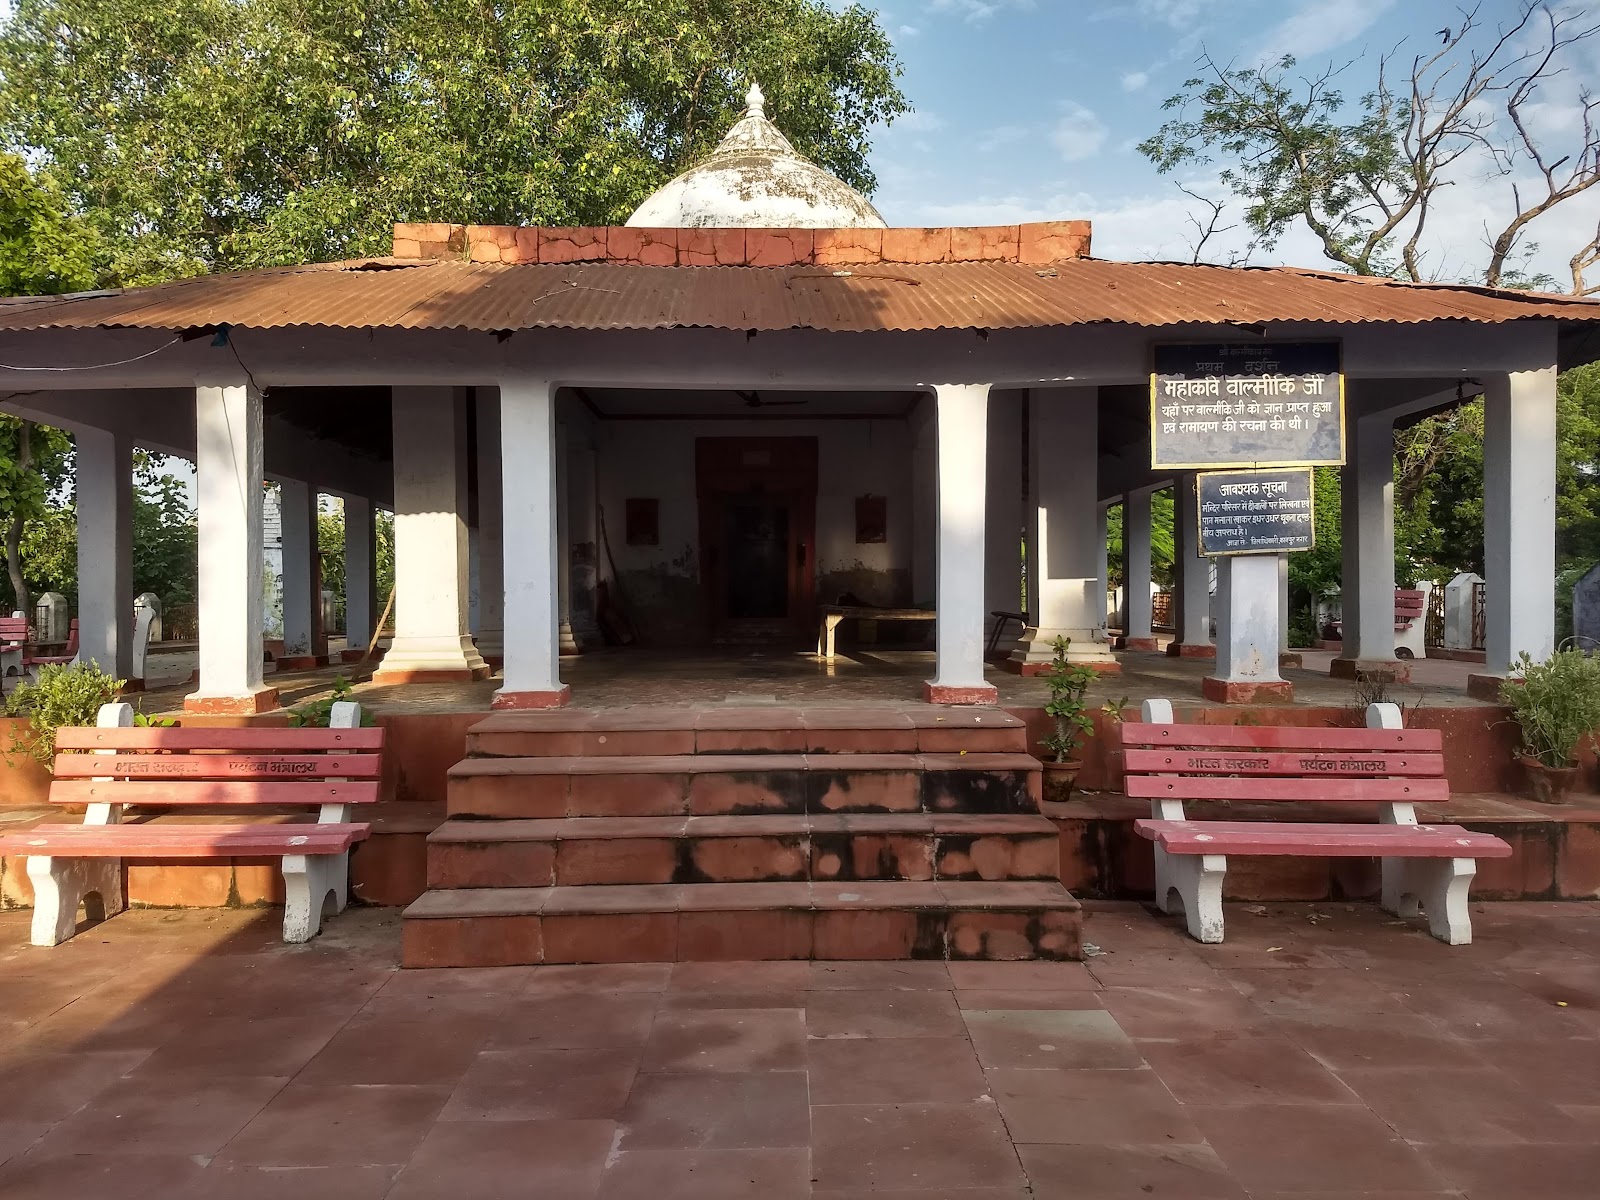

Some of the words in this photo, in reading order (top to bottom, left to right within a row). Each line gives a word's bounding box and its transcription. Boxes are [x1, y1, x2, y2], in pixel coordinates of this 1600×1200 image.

[1196, 361, 1225, 372] प्रथम
[1245, 357, 1280, 373] दर्शन
[1164, 376, 1220, 401] महाकवि
[1226, 374, 1296, 396] वाल्मीकि
[1302, 374, 1325, 395] जी
[1181, 405, 1195, 416] पर
[1196, 400, 1231, 416] वाल्मीकि
[1233, 399, 1245, 416] जी
[1247, 400, 1260, 414] को
[1264, 403, 1284, 415] ज्ञान
[1286, 402, 1310, 413] प्राप्त
[1312, 402, 1332, 418] हुआ
[1179, 421, 1219, 433] रामायण
[1222, 416, 1237, 432] की
[1239, 420, 1267, 431] रचना
[1270, 415, 1285, 430] की
[1219, 483, 1259, 496] आवश्यक
[1262, 481, 1287, 497] सूचना
[1202, 501, 1220, 513] मन्दिर
[1221, 500, 1240, 511] परिसर
[1268, 501, 1278, 509] पर
[1279, 498, 1300, 509] लिखना
[1300, 498, 1310, 508] एवं
[1202, 517, 1213, 525] पान
[1214, 516, 1233, 524] मसाला
[1233, 515, 1252, 524] खाकर
[1252, 514, 1265, 525] इधर
[1265, 514, 1279, 523] उधर
[1202, 526, 1214, 537] नीय
[1215, 529, 1238, 537] अपराध
[229, 757, 269, 773] पर्यटन
[270, 758, 318, 773] मंत्रालय
[1187, 757, 1222, 769] भारत
[1224, 758, 1269, 770] सरकार
[1299, 756, 1337, 771] पर्यटन
[1340, 756, 1387, 771] मंत्रालय
